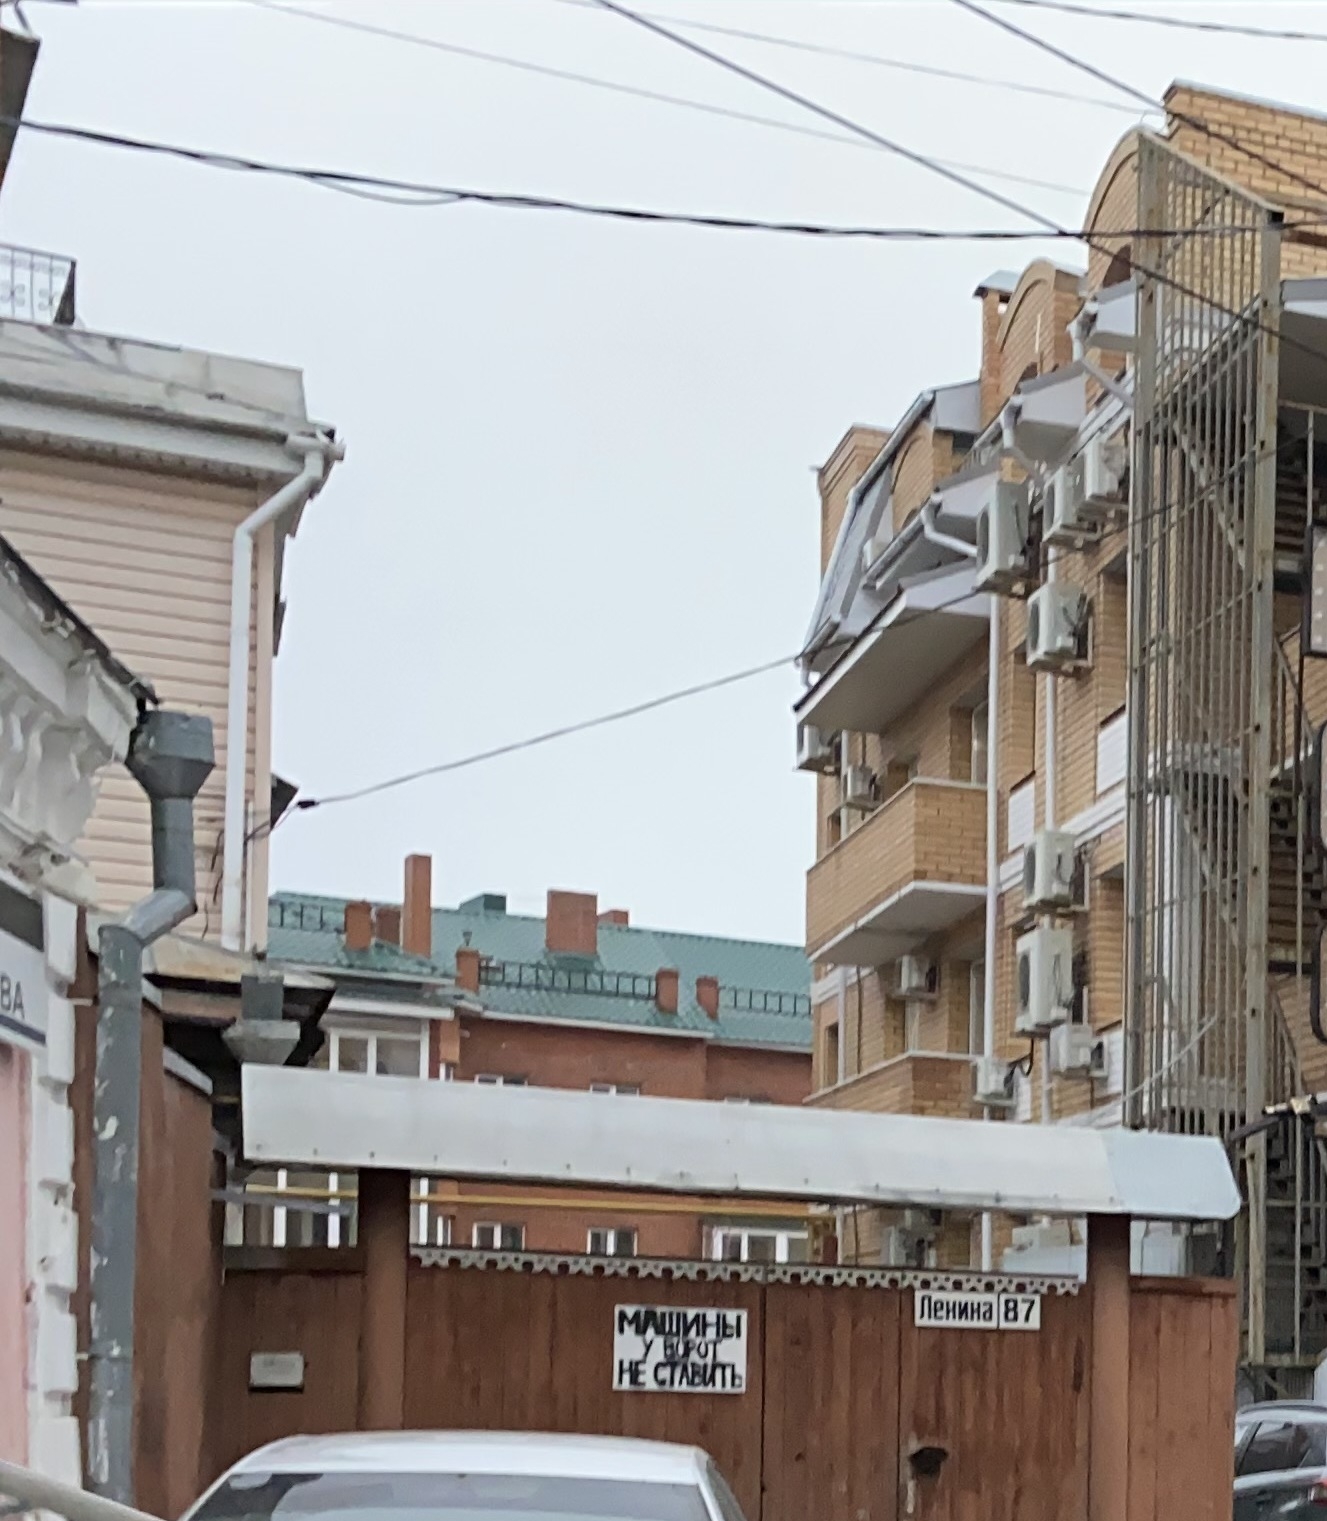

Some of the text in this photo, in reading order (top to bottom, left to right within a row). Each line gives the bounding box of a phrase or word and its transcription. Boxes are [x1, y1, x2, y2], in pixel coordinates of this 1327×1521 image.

[920, 1295, 1035, 1322] Ленина 87
[618, 1309, 742, 1338] МАШИНЫ
[664, 1336, 723, 1362] ВОРОТ
[618, 1360, 743, 1388] НЕ СТАВИТЬ
